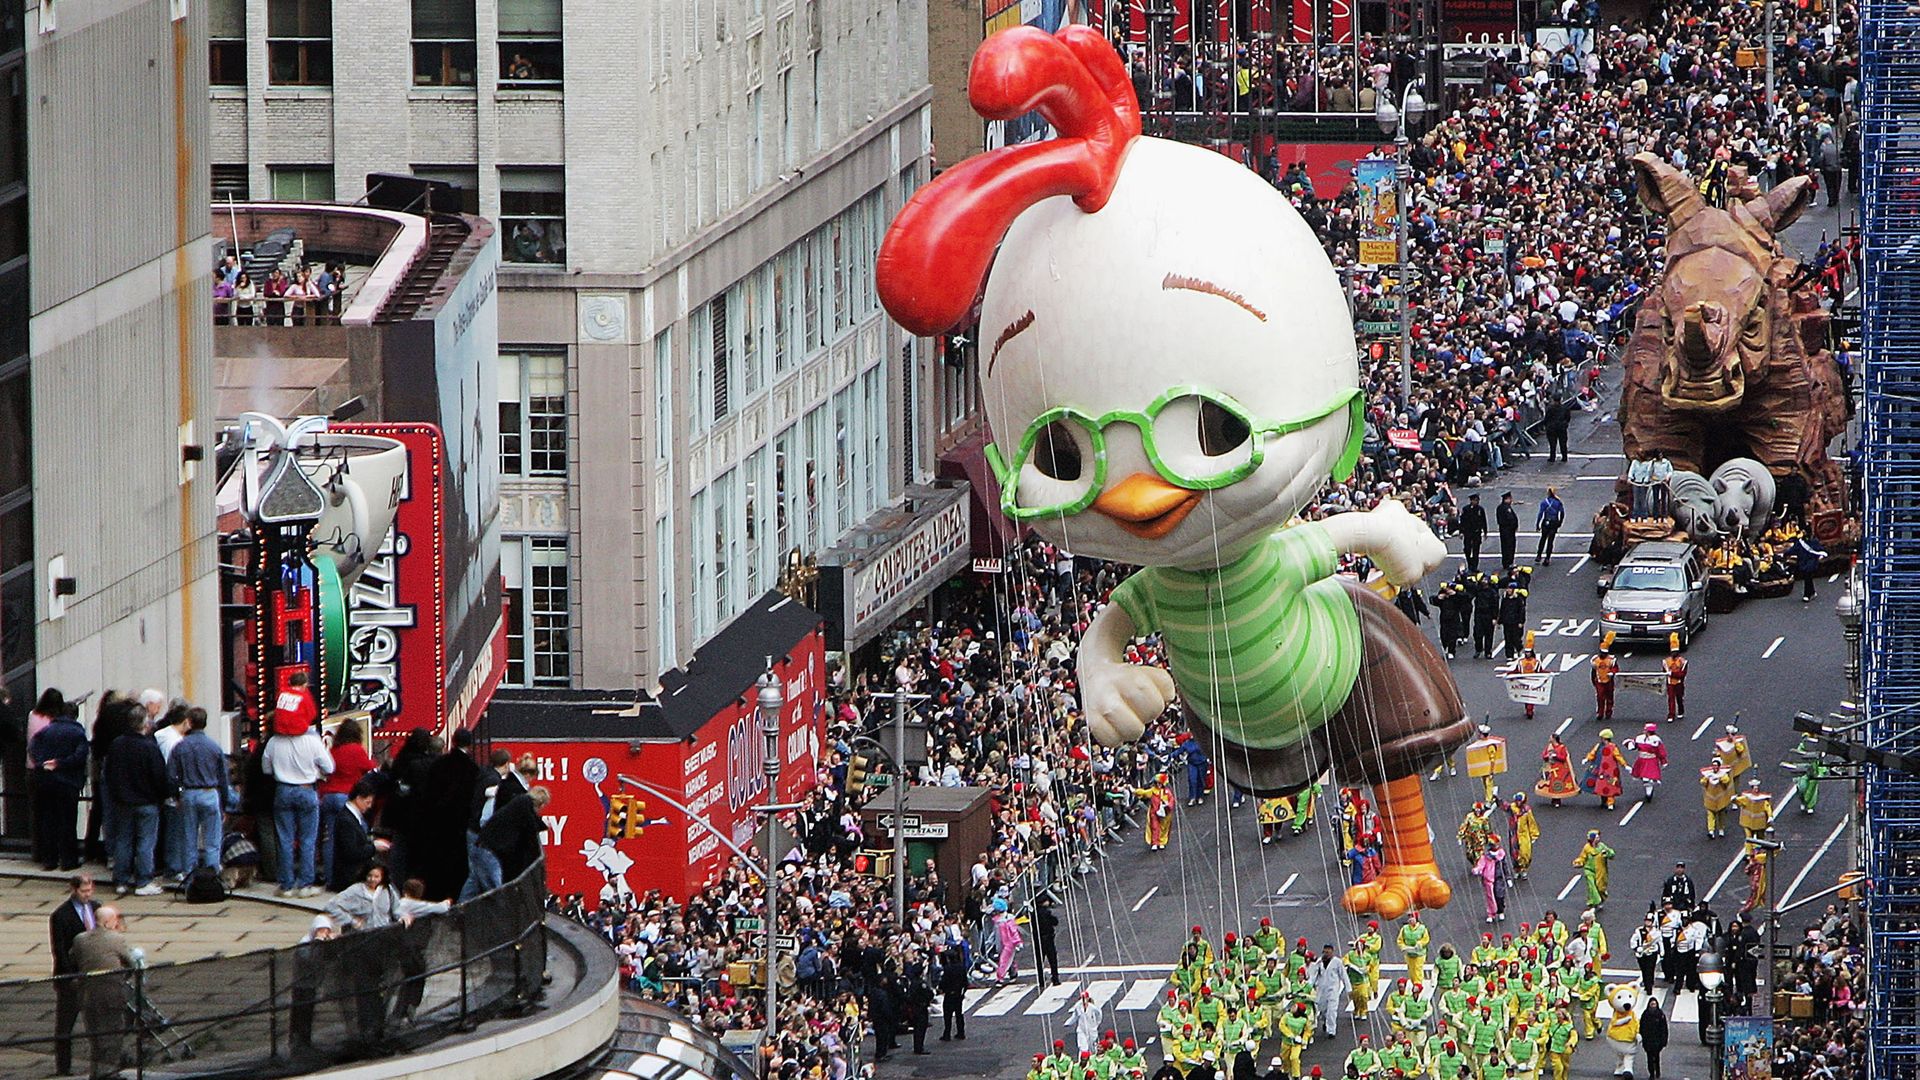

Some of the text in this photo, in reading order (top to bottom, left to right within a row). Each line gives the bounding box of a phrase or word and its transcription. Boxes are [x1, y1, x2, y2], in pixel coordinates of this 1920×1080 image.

[873, 531, 925, 594] COMPUTER
[933, 503, 962, 550] VIDEO
[975, 559, 999, 568] ATM
[1533, 619, 1600, 637] RE
[728, 705, 768, 814] COLO
